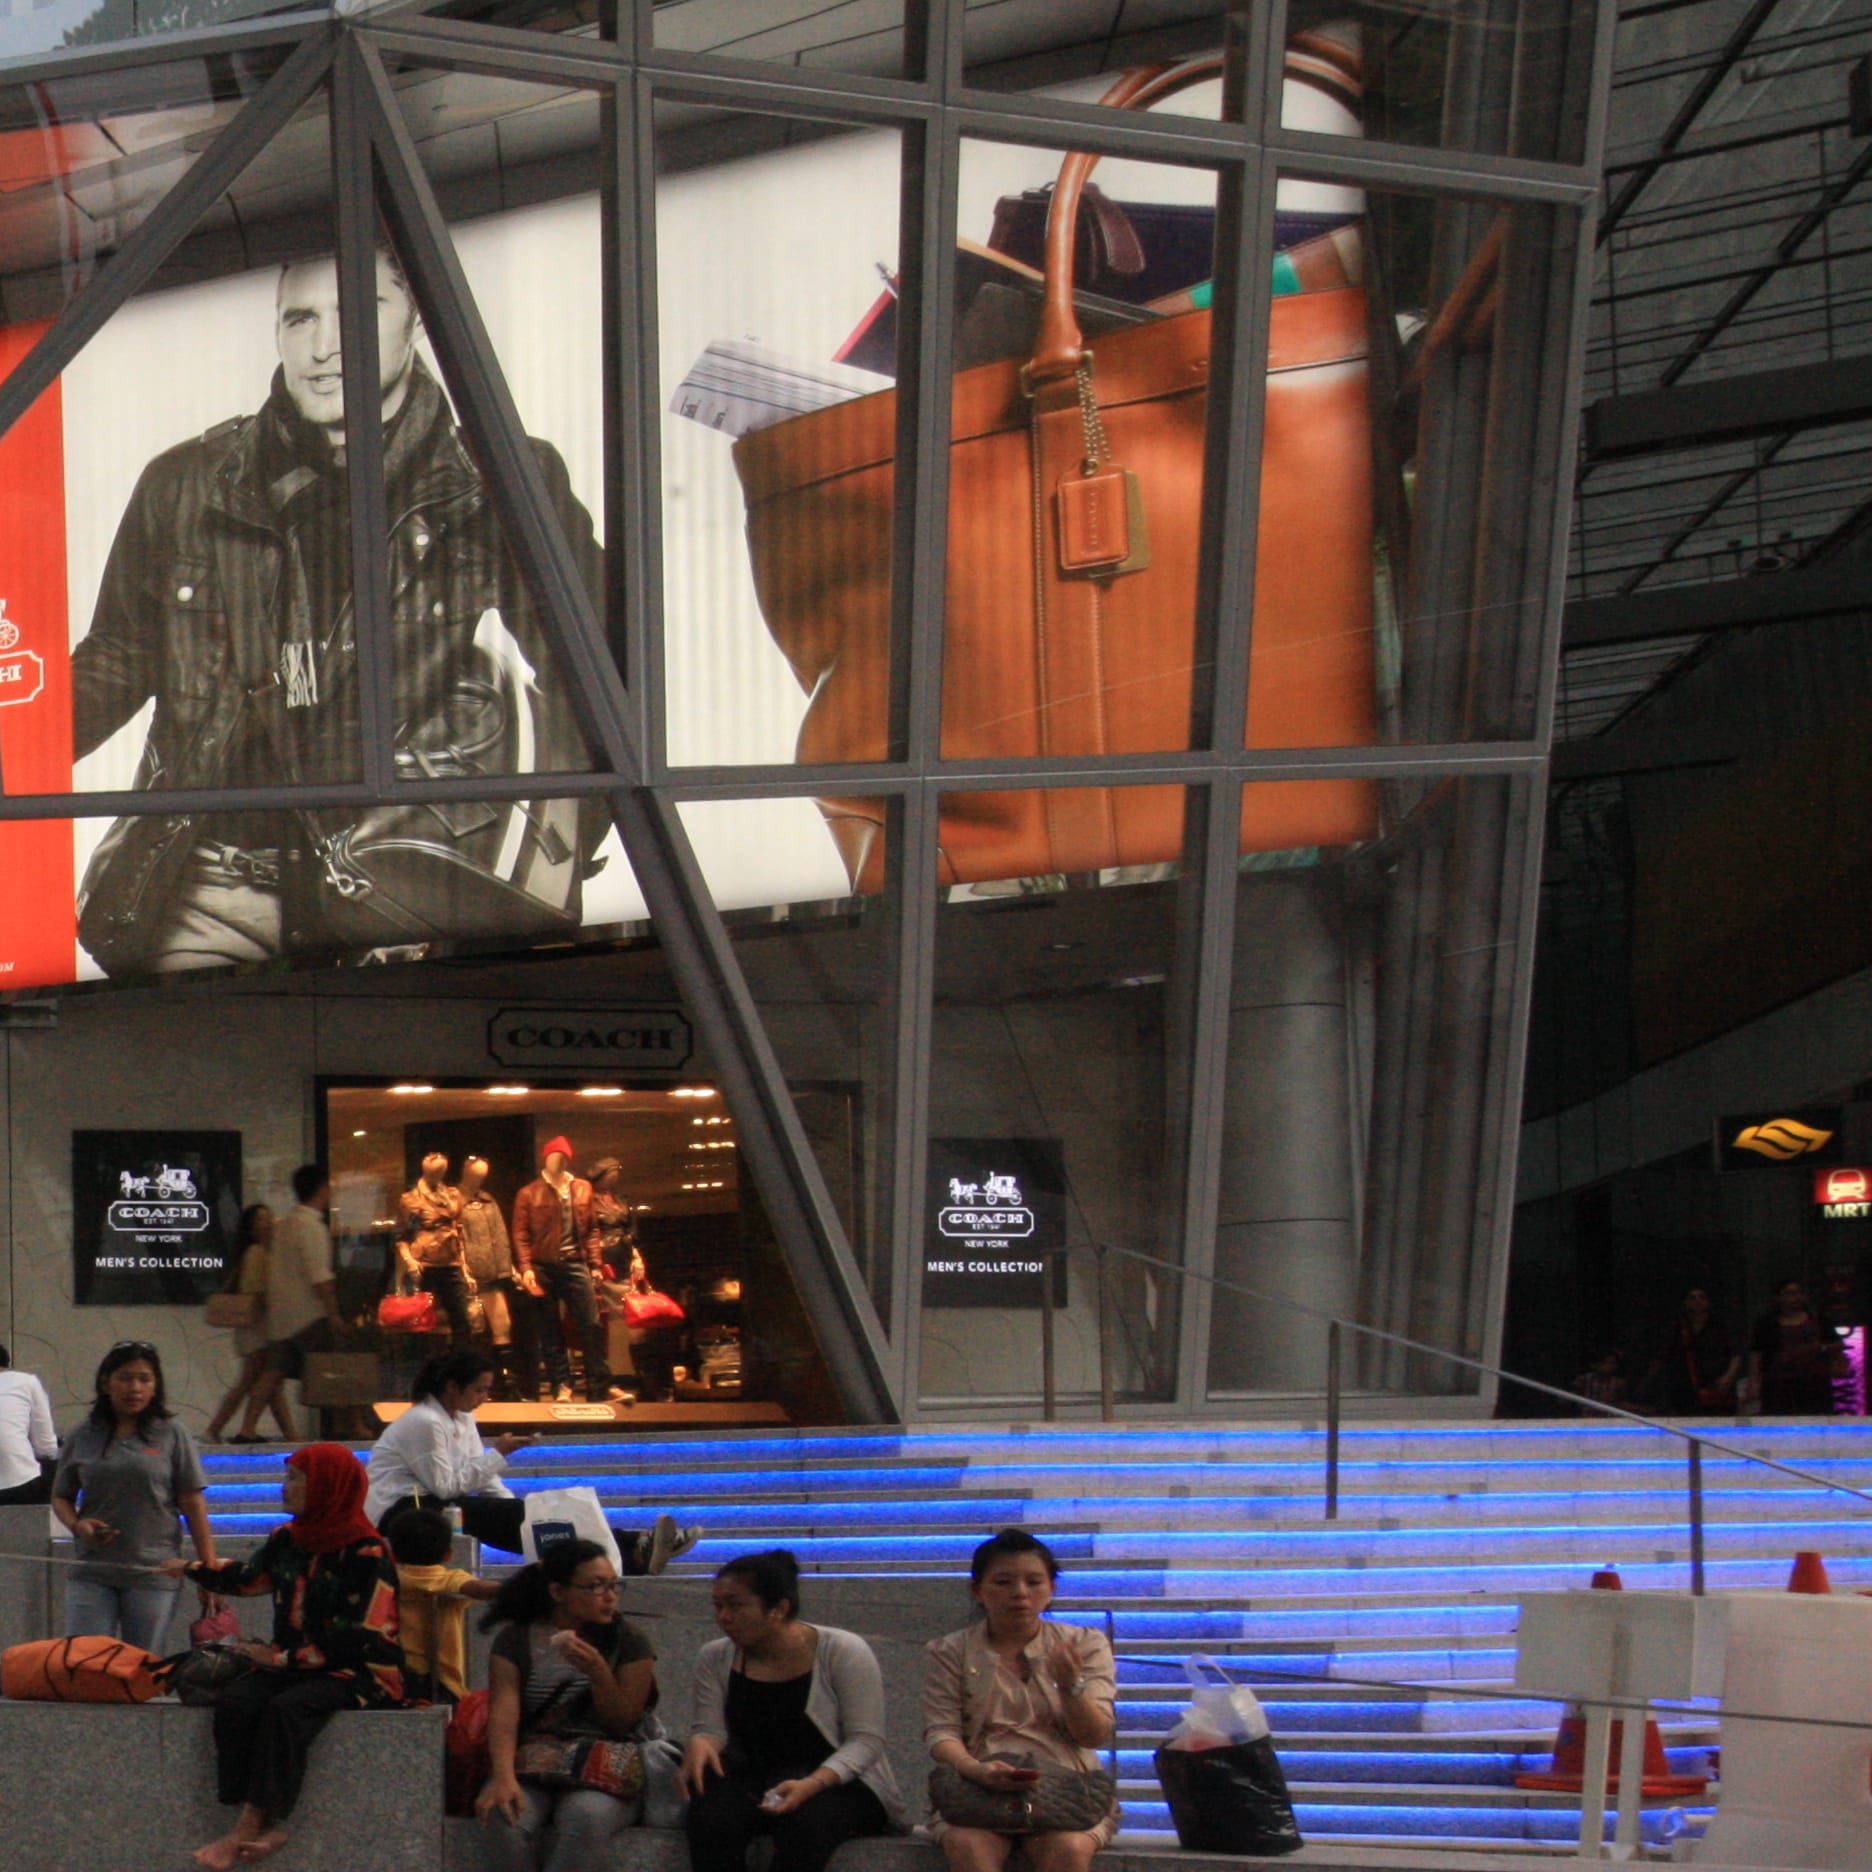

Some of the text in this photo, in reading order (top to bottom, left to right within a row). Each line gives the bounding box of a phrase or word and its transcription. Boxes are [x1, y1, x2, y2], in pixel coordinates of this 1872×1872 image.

[508, 1026, 673, 1050] COACH
[118, 1207, 199, 1218] COACH
[1823, 1201, 1871, 1218] MRT
[948, 1213, 1024, 1224] COACH
[135, 1234, 183, 1243] NEW YORK
[964, 1240, 1009, 1248] NEW YORK
[95, 1257, 223, 1268] MEN'S COLLECTION
[927, 1261, 964, 1272] MEN'S
